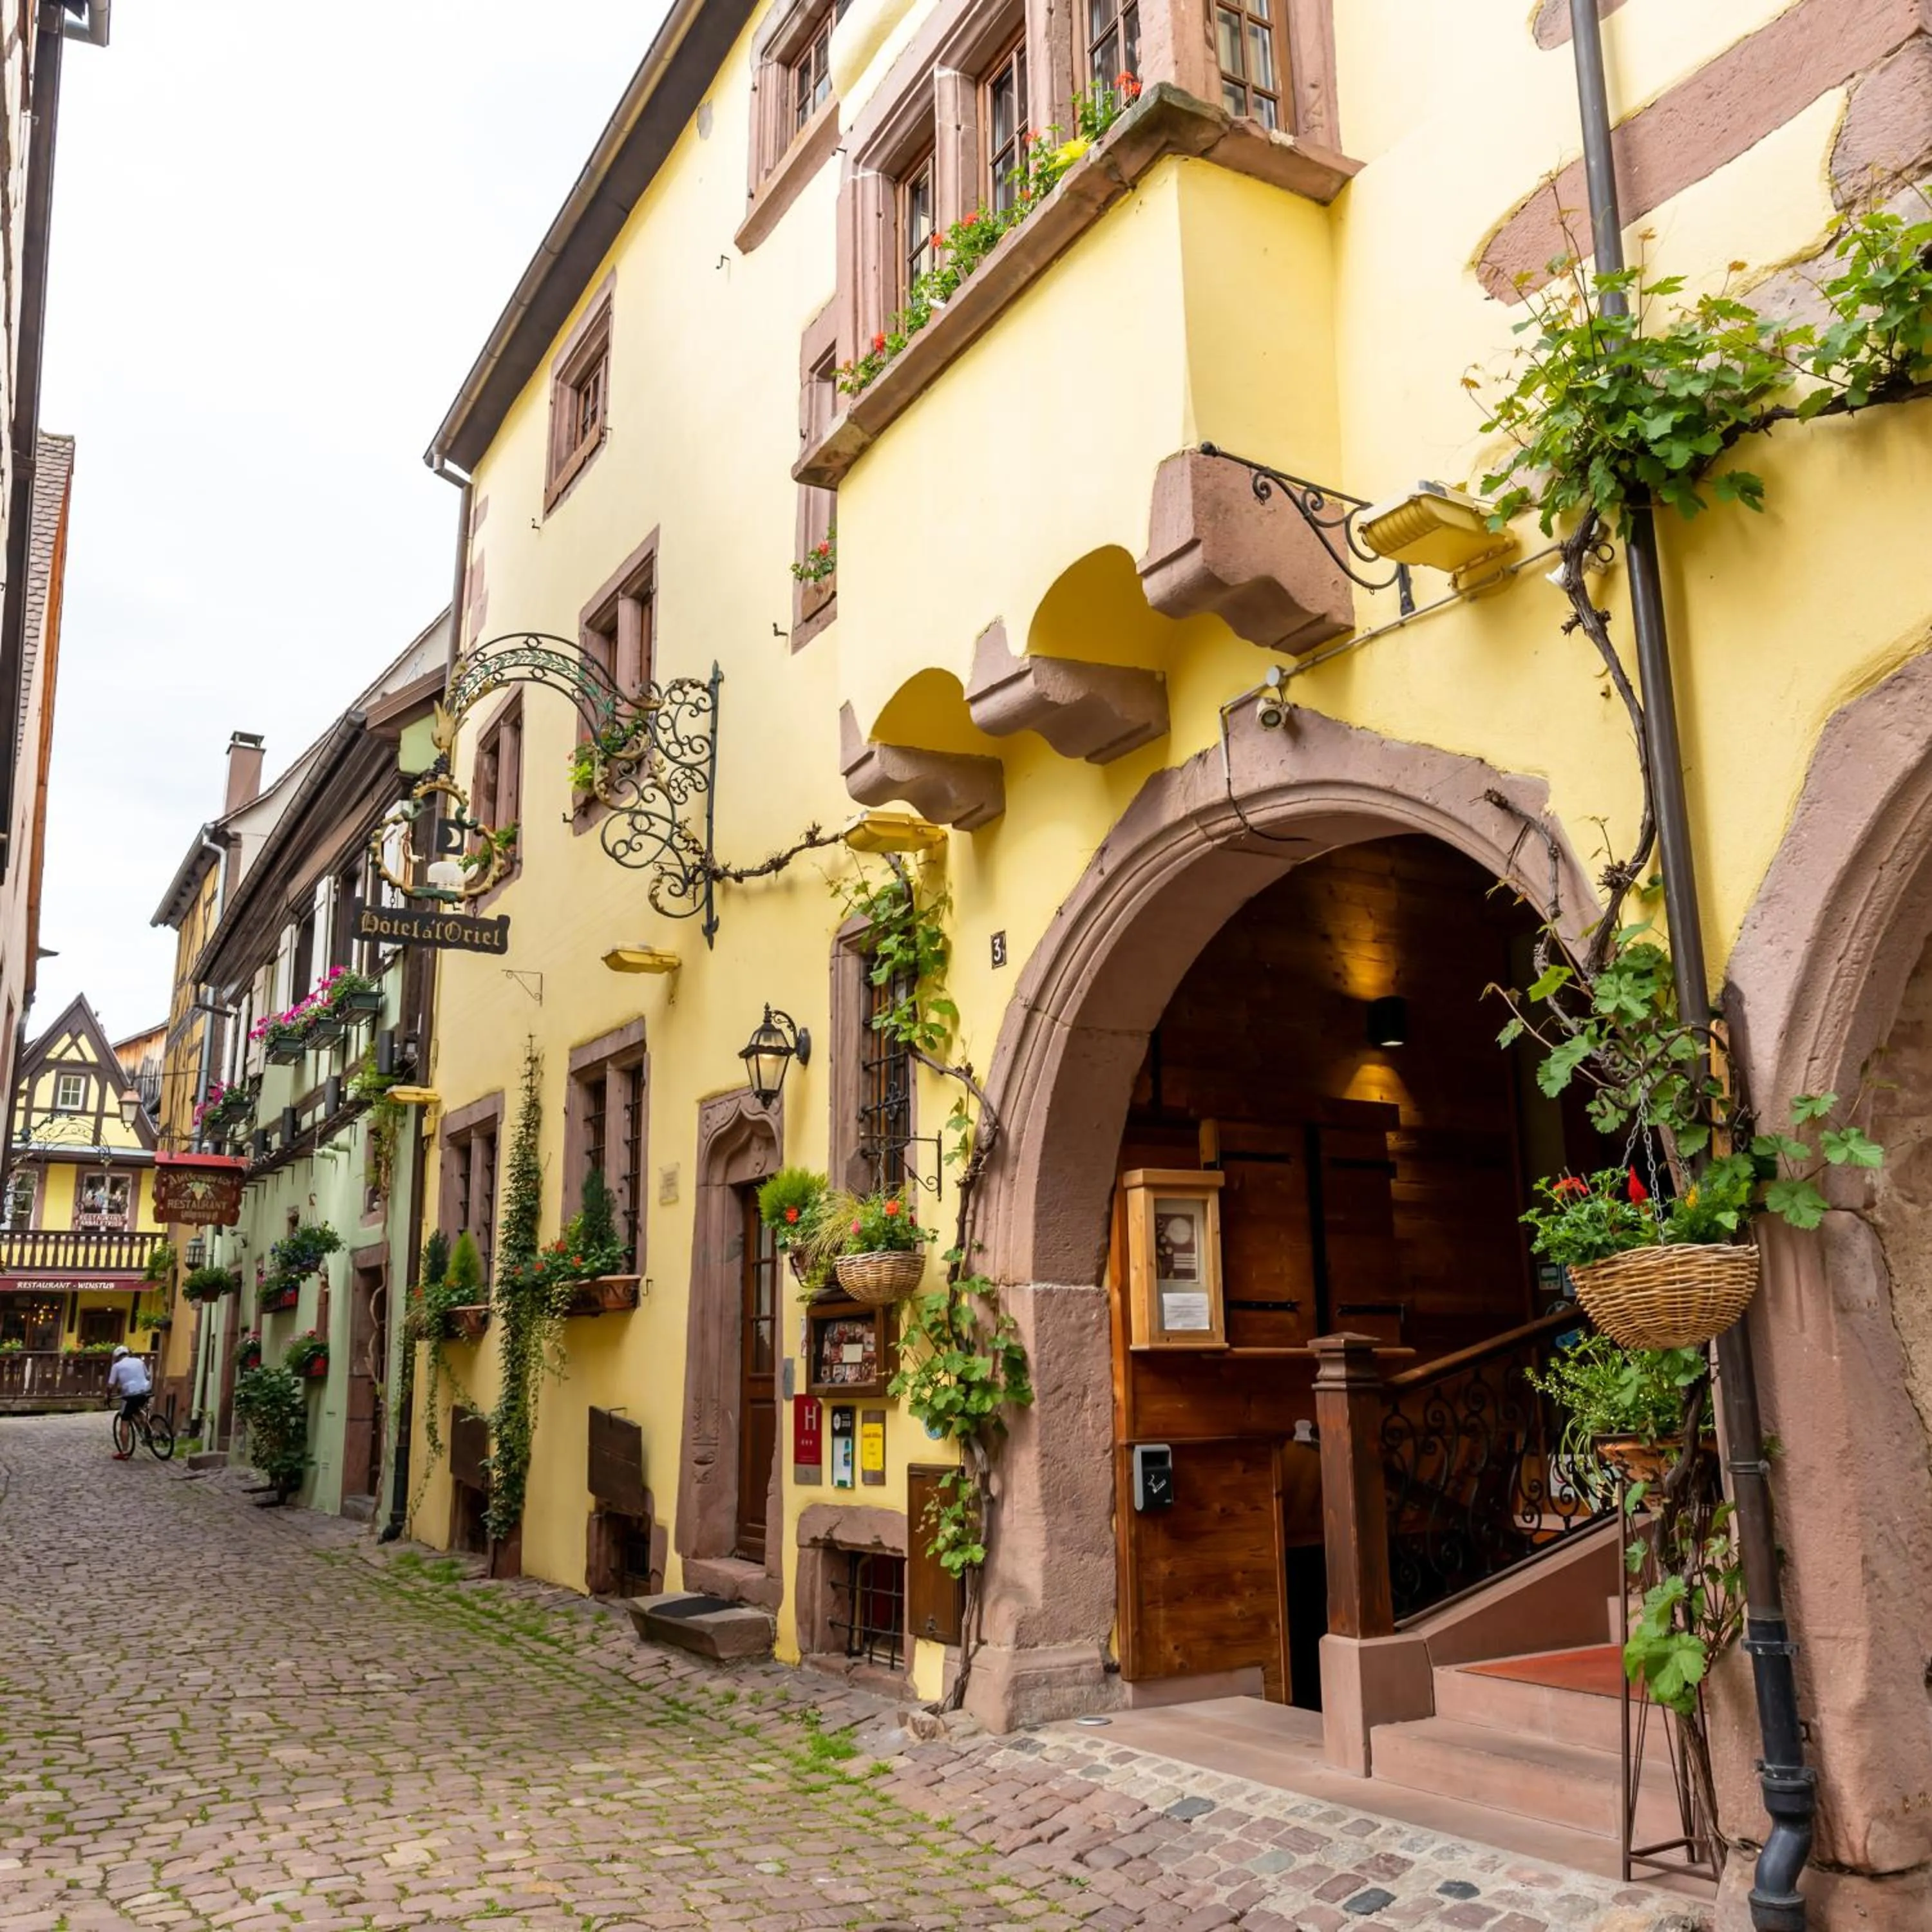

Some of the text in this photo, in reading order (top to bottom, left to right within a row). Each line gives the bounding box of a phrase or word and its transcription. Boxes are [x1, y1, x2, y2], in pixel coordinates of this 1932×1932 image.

[435, 920, 501, 947] l'Oriel
[994, 938, 1002, 961] 3
[167, 1198, 227, 1210] RESTAURANT
[804, 1406, 817, 1430] H
